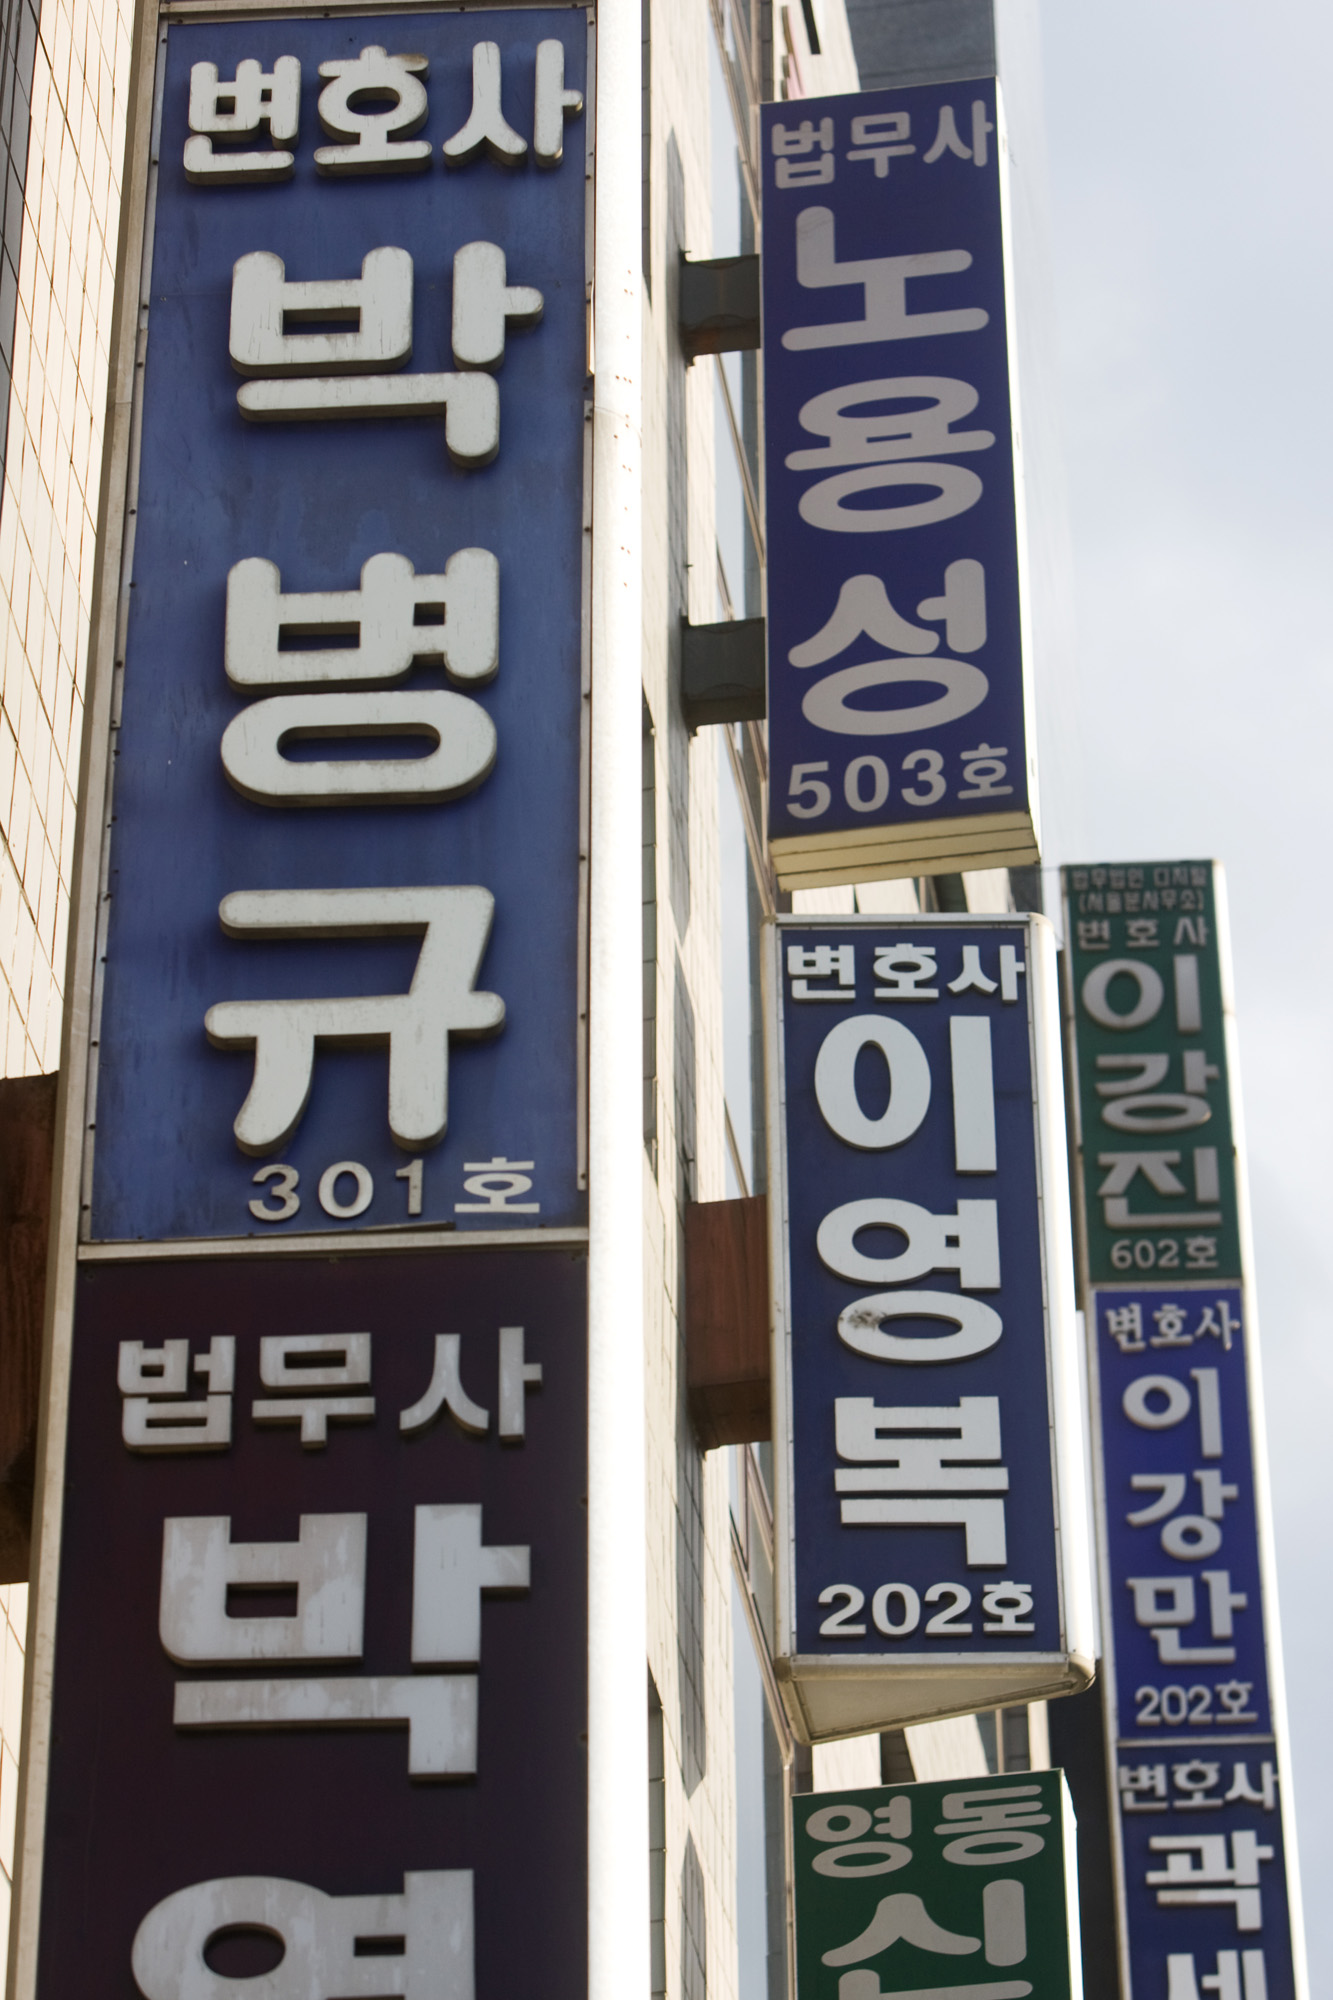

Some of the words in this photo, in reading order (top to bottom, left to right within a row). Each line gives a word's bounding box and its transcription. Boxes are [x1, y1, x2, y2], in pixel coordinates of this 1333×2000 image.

[183, 39, 583, 183] 변호사
[771, 99, 993, 189] 법무사
[781, 206, 996, 736] 노용성
[204, 240, 544, 1156] 박병규
[786, 742, 1014, 819] 503호
[787, 943, 1025, 1003] 변호사
[1077, 916, 1209, 951] 변호사
[1082, 954, 1222, 1229] 이강진
[248, 1157, 540, 1221] 301호
[814, 1014, 1009, 1567] 이영복
[1110, 1236, 1218, 1270] 602호
[1105, 1300, 1241, 1351] 변호사
[117, 1327, 543, 1453] 법무사
[1122, 1367, 1247, 1664] 이강만
[818, 1580, 1035, 1638] 202호
[1135, 1681, 1258, 1726] 202호
[1118, 1759, 1279, 1811] 변호사
[805, 1785, 1052, 1878] 영동
